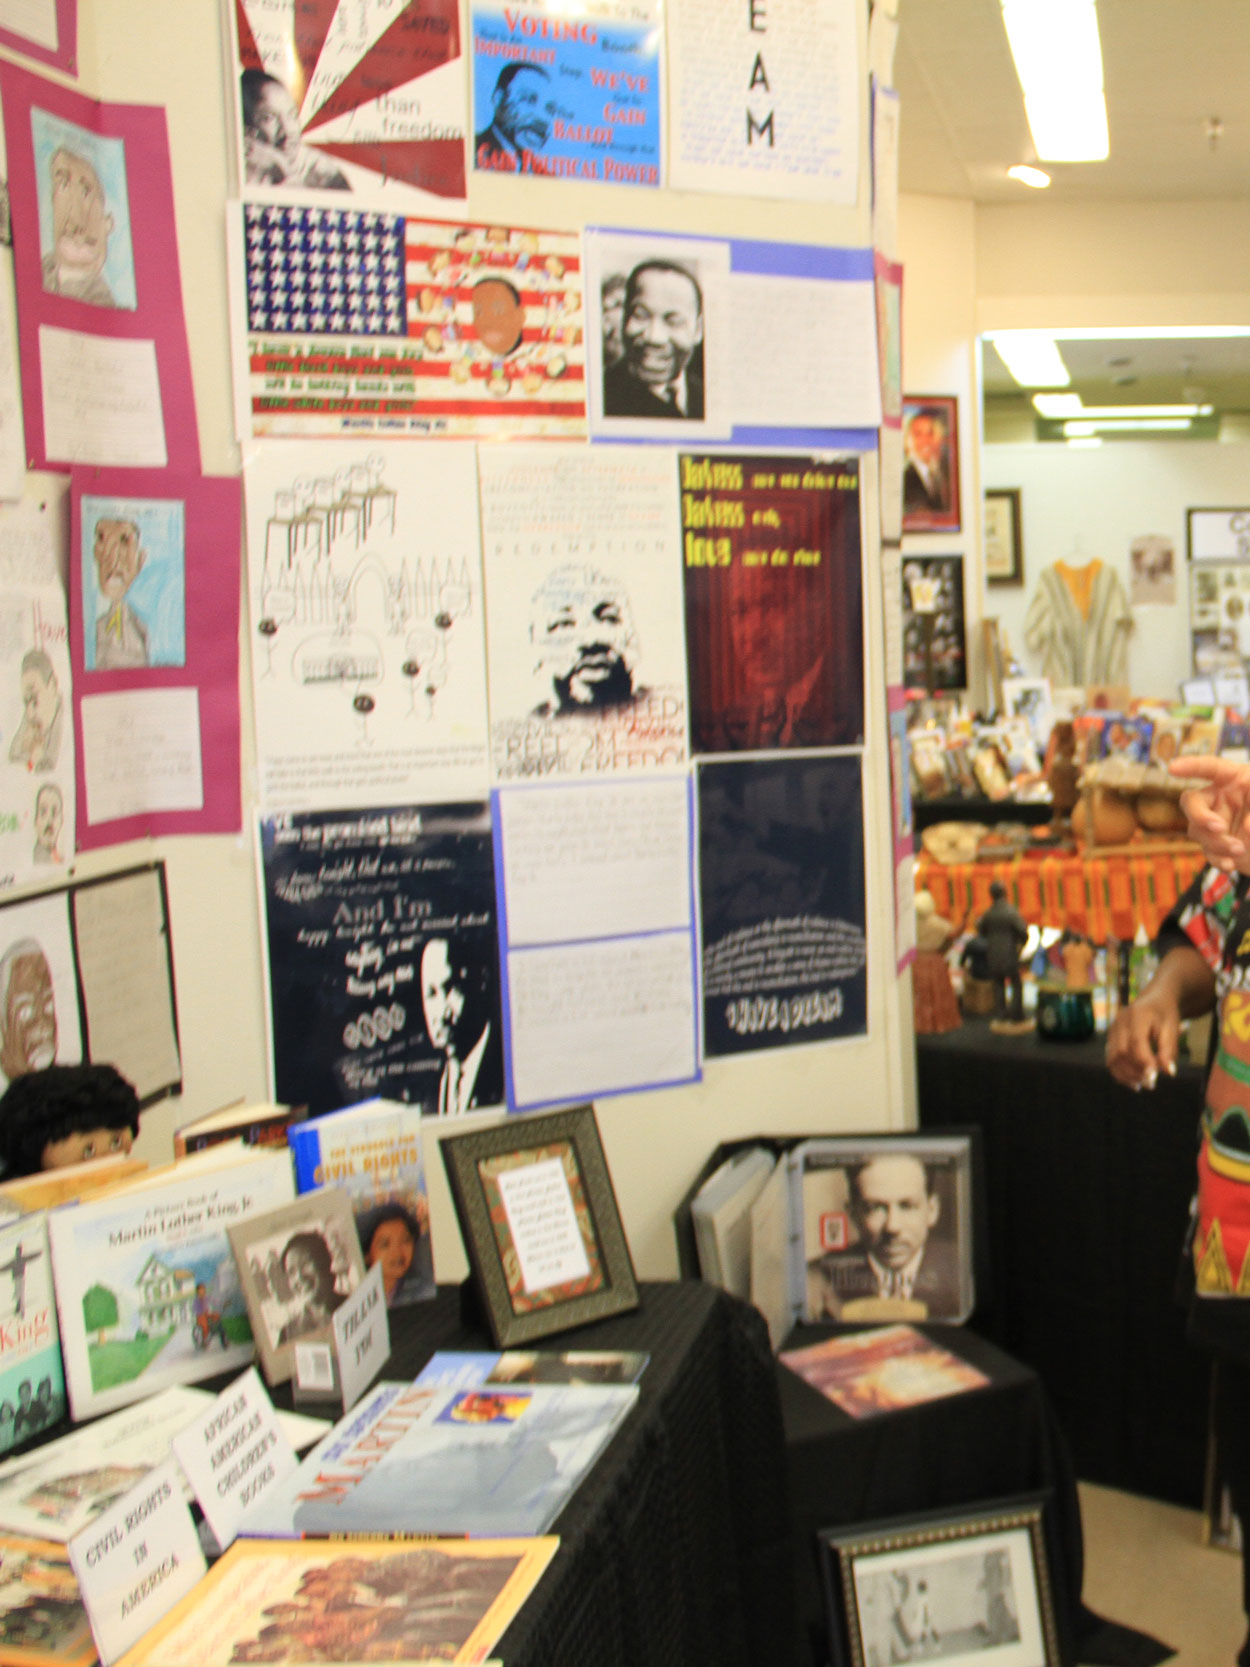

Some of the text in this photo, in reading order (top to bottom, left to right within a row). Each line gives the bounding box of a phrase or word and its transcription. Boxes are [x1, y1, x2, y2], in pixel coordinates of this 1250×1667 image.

[375, 92, 421, 116] than
[383, 117, 462, 140] freedom
[603, 155, 659, 185] POWER
[332, 893, 433, 926] And I'm
[314, 1147, 417, 1185] CIVIL RIGHTS
[108, 1223, 157, 1248] Martin
[161, 1211, 203, 1233] Luther
[204, 1391, 248, 1445] AFRICAN
[210, 1410, 262, 1472] AMERICAN
[295, 1388, 438, 1506] MARTIN
[240, 1461, 276, 1508] BOOKS
[85, 1481, 172, 1569] CIVIL RIGHTS
[133, 1540, 148, 1567] IN
[121, 1551, 180, 1621] AMERICA
